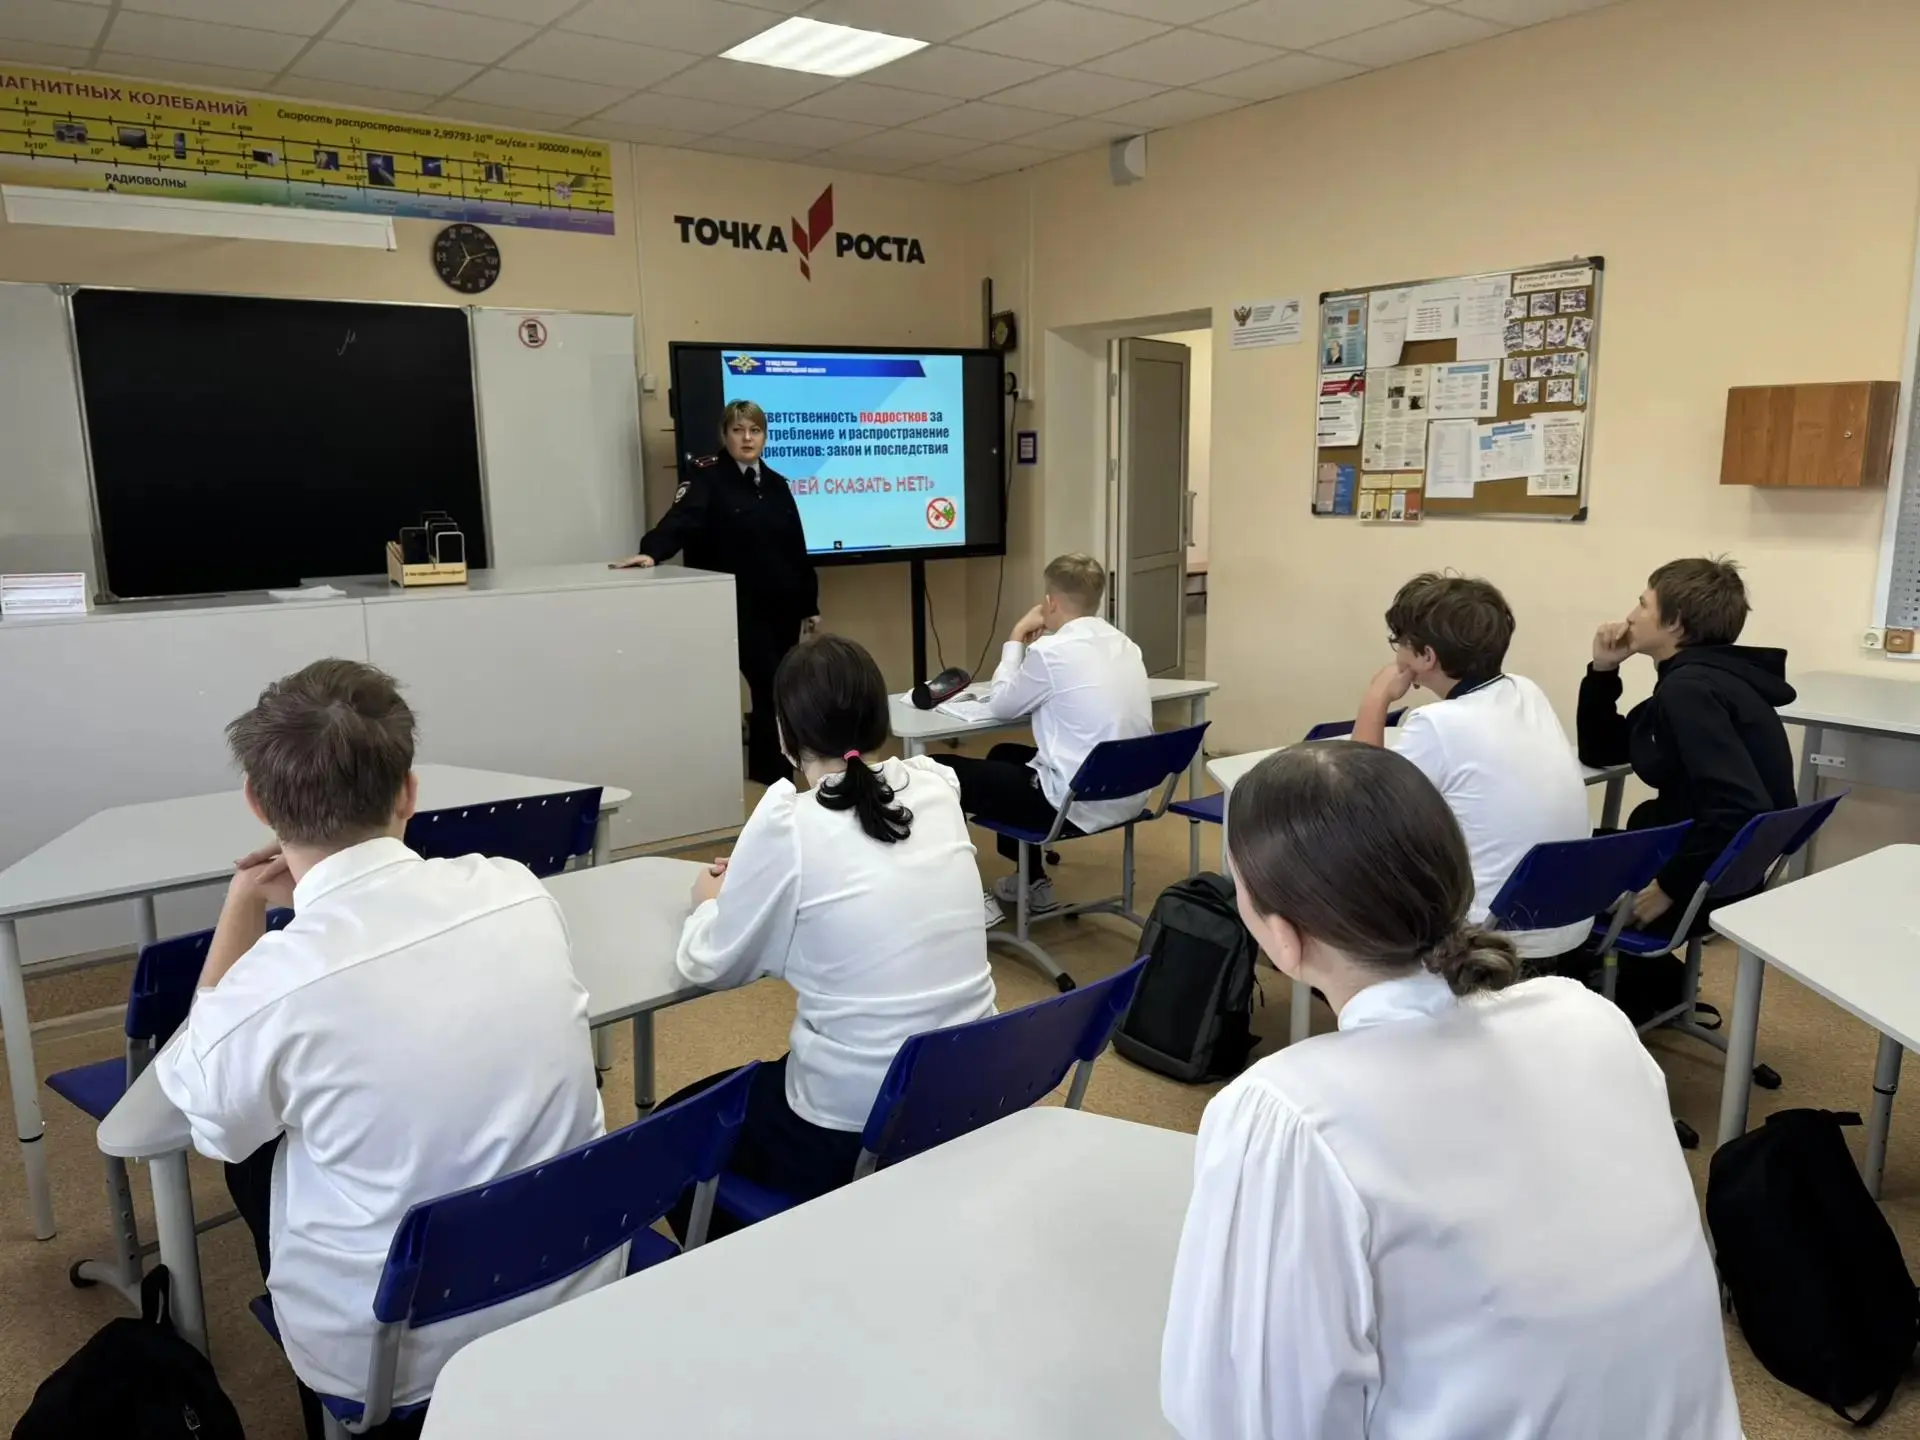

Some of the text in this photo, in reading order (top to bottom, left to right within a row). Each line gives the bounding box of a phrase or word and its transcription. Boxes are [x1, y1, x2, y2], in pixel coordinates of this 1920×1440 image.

[0, 75, 248, 117] АГНИТНЫХ КОЛЕБАНИЙ
[277, 109, 333, 126] Скорость
[335, 117, 431, 137] распространения
[105, 173, 187, 189] РАДИОВОЛНЫ
[674, 215, 925, 264] ТОЧКА РОСТА
[764, 411, 943, 425] ветственность подростков за
[767, 426, 950, 442] требление и распространение
[761, 443, 949, 460] ркотиков: закон и последствия
[824, 476, 892, 495] СКАЗАТЬ
